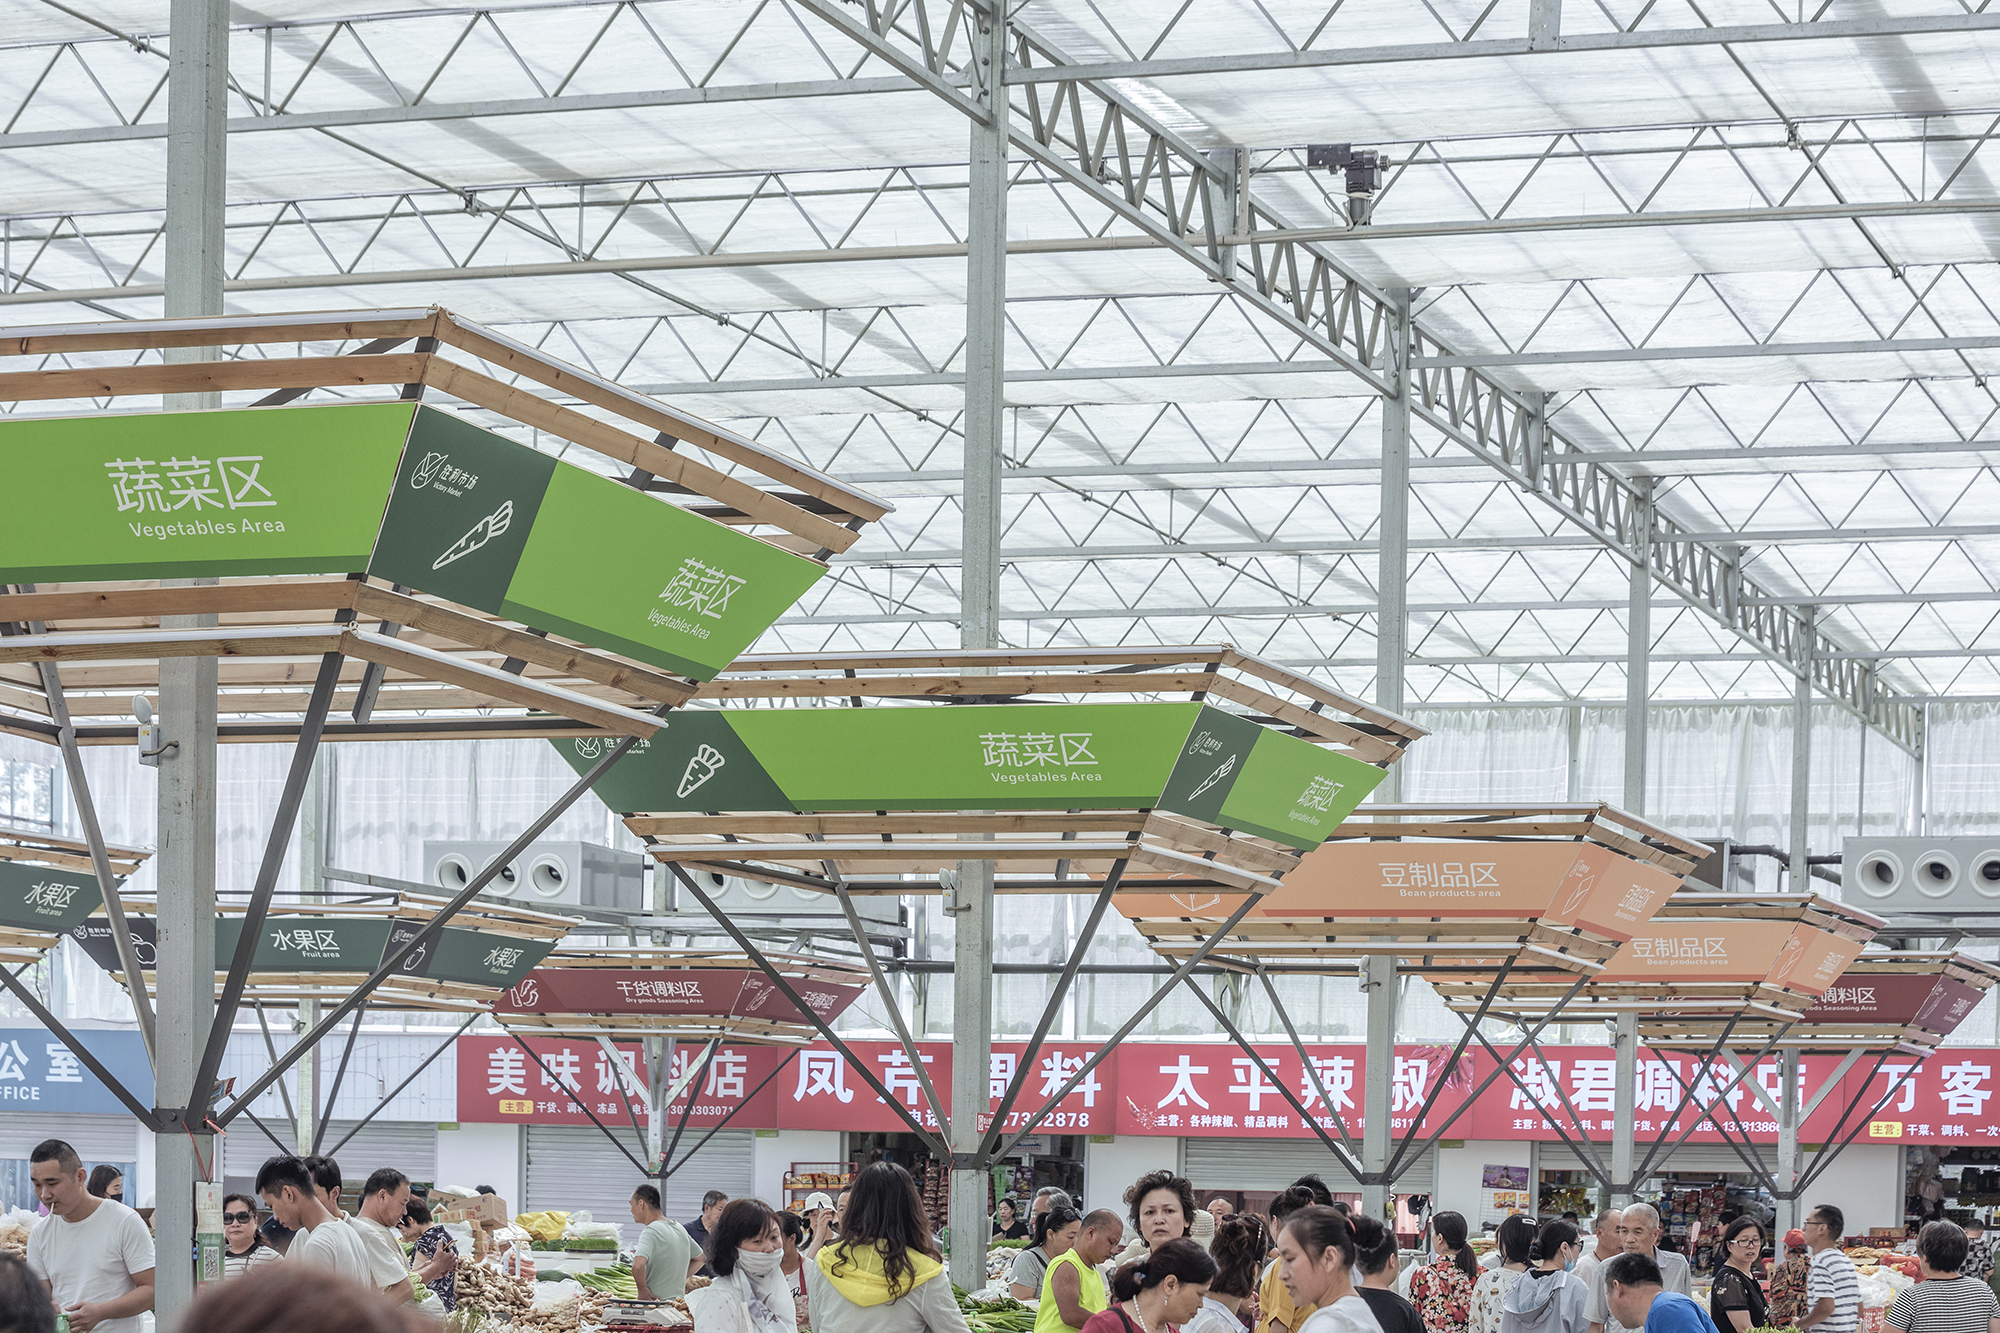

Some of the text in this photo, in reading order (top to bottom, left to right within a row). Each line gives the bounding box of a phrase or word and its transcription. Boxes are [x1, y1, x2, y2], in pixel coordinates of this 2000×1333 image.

[104, 455, 278, 513] 蔬菜区
[438, 464, 479, 490] 胜利市场
[129, 518, 286, 540] Vegetables Area
[658, 557, 747, 620] 蔬菜区
[647, 608, 711, 640] Vegetables Area
[979, 732, 1099, 767] 蔬菜区
[990, 771, 1102, 785] Vegetables Area
[1296, 775, 1344, 812] 蔬菜区
[1378, 862, 1500, 888] 豆制品区
[24, 881, 80, 908] 水果区
[1400, 889, 1426, 897] Bean
[1429, 889, 1476, 898] products
[35, 906, 50, 915] Fruit
[270, 929, 340, 951] 水果区
[1630, 937, 1727, 958] 豆制品区
[302, 950, 321, 958] Fruit
[483, 946, 524, 968] 水果区
[616, 981, 702, 997] 干货调料区
[1815, 987, 1877, 1004] 调料区
[0, 1039, 83, 1083] 公室
[1157, 1055, 1429, 1112] 太平辣椒
[1871, 1060, 1993, 1116] 万客
[1906, 1123, 2000, 1137] 干菜、调料、一次
